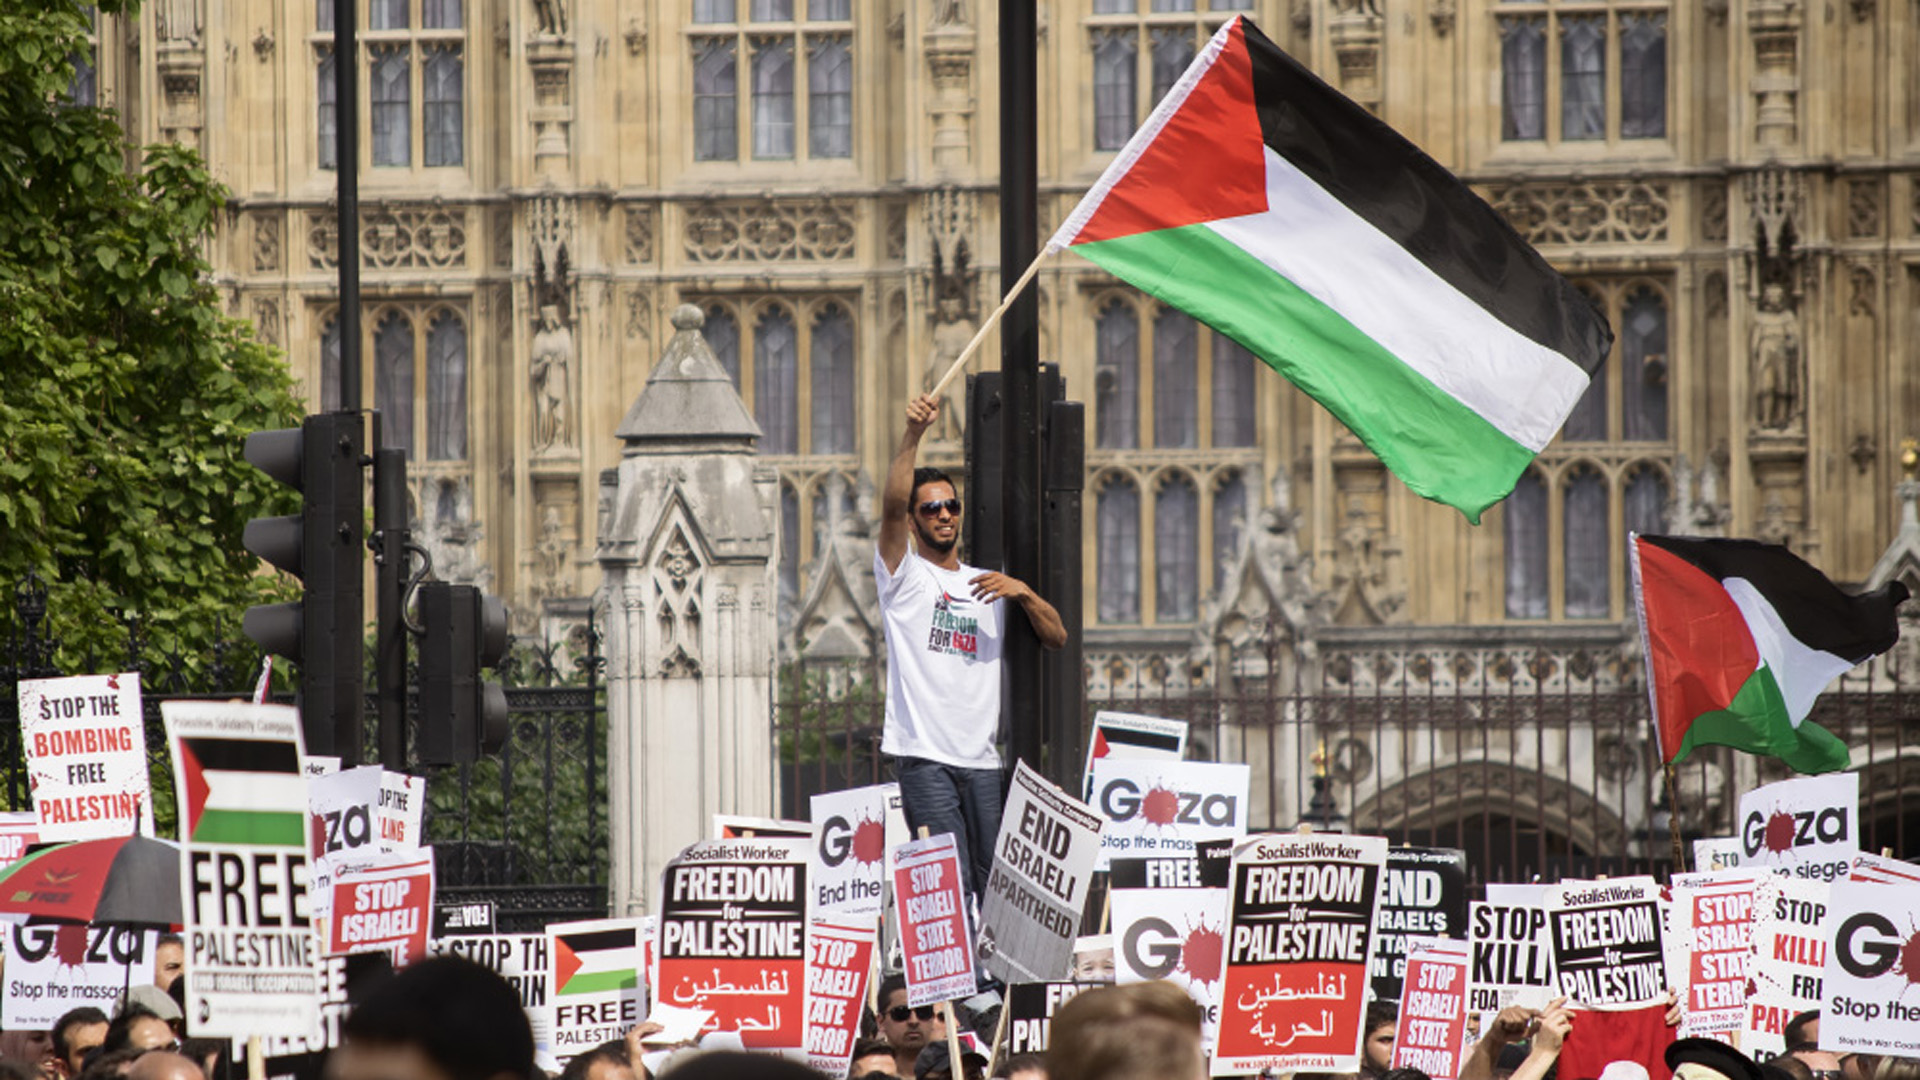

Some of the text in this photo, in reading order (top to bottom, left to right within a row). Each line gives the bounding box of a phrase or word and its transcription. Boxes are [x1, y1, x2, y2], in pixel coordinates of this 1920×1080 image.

[929, 627, 951, 647] FOR
[40, 695, 120, 720] STOP THE
[34, 726, 132, 757] BOMBING
[67, 763, 106, 785] FREE
[1100, 778, 1237, 827] Gza
[1019, 799, 1071, 860] END
[1134, 834, 1156, 849] the
[1160, 838, 1198, 851] mas
[1743, 807, 1848, 858] Gza
[0, 836, 23, 858] OP
[1712, 852, 1739, 868] STO
[910, 863, 943, 894] STOP
[1002, 832, 1076, 902] ISRAELI
[1146, 860, 1201, 888] FREE
[1796, 860, 1849, 883] siege
[191, 852, 310, 925] FREE
[355, 880, 410, 912] STOP
[673, 866, 795, 902] FREEDOM
[819, 879, 880, 906] End the
[1245, 865, 1364, 904] FREEDOM
[722, 901, 744, 919] for
[906, 889, 956, 924] ISRAELI
[990, 868, 1072, 940] APARTHEID
[1289, 903, 1308, 922] for
[1698, 894, 1751, 923] STOP
[1774, 896, 1827, 925] STOP
[341, 907, 419, 943] ISRAELI
[915, 919, 955, 951] STATE
[1380, 910, 1448, 932] RAEL'S
[1474, 905, 1546, 941] STOP
[1559, 906, 1655, 950] FREEDOM
[14, 924, 143, 964] Gza
[193, 933, 314, 966] PALESTINE
[521, 938, 547, 971] TH
[663, 921, 802, 957] PALESTINE
[1232, 922, 1366, 962] PALESTINE
[1773, 933, 1827, 968] KILLI
[1373, 958, 1387, 977] N
[1605, 948, 1622, 965] for
[11, 981, 43, 1001] Stop
[47, 982, 68, 998] the
[673, 968, 789, 1002] لفلسطين
[811, 966, 860, 998] RAELI
[1237, 972, 1346, 1011] لفلسطين
[1418, 963, 1456, 991] STOP
[1560, 962, 1664, 1004] PALESTINE
[556, 998, 636, 1027] FREE
[1407, 991, 1460, 1020] ISRAELI
[1470, 989, 1498, 1011] FOA
[1831, 996, 1920, 1022] Stop the
[1249, 1009, 1334, 1047] الحرية
[1408, 1020, 1449, 1047] STATE
